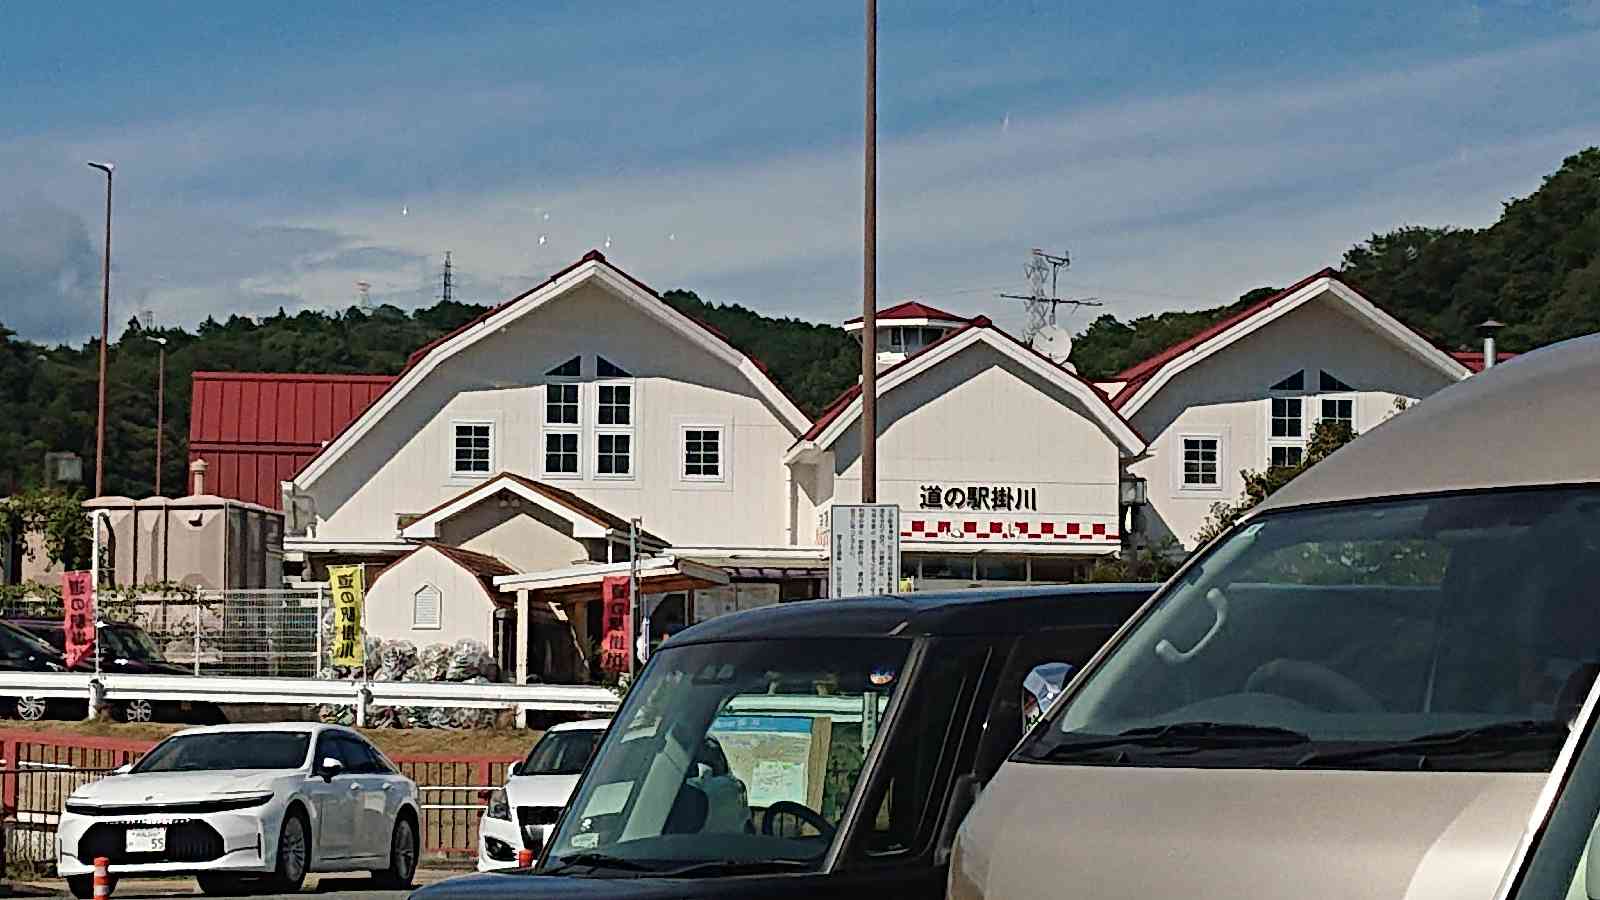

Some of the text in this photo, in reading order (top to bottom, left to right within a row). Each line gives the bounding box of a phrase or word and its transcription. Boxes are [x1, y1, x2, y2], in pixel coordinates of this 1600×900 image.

[919, 484, 1037, 511] 道の駅掛川
[151, 837, 164, 850] 55
